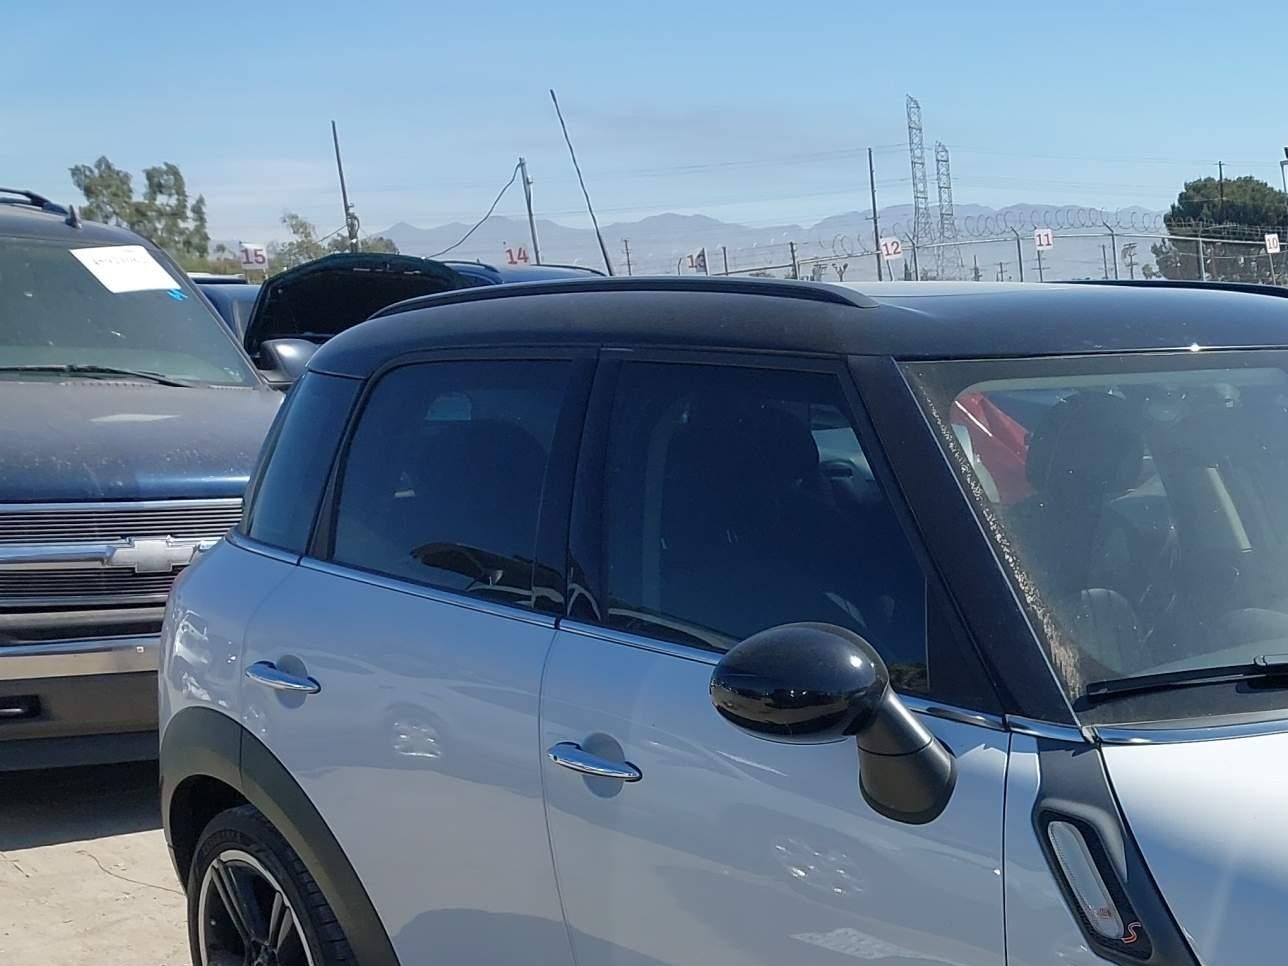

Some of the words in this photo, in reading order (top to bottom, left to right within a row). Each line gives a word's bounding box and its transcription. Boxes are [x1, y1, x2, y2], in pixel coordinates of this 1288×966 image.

[1036, 233, 1052, 246] 11
[1267, 237, 1279, 249] 10
[239, 248, 266, 264] 15
[505, 247, 529, 264] 14
[882, 240, 902, 256] 12
